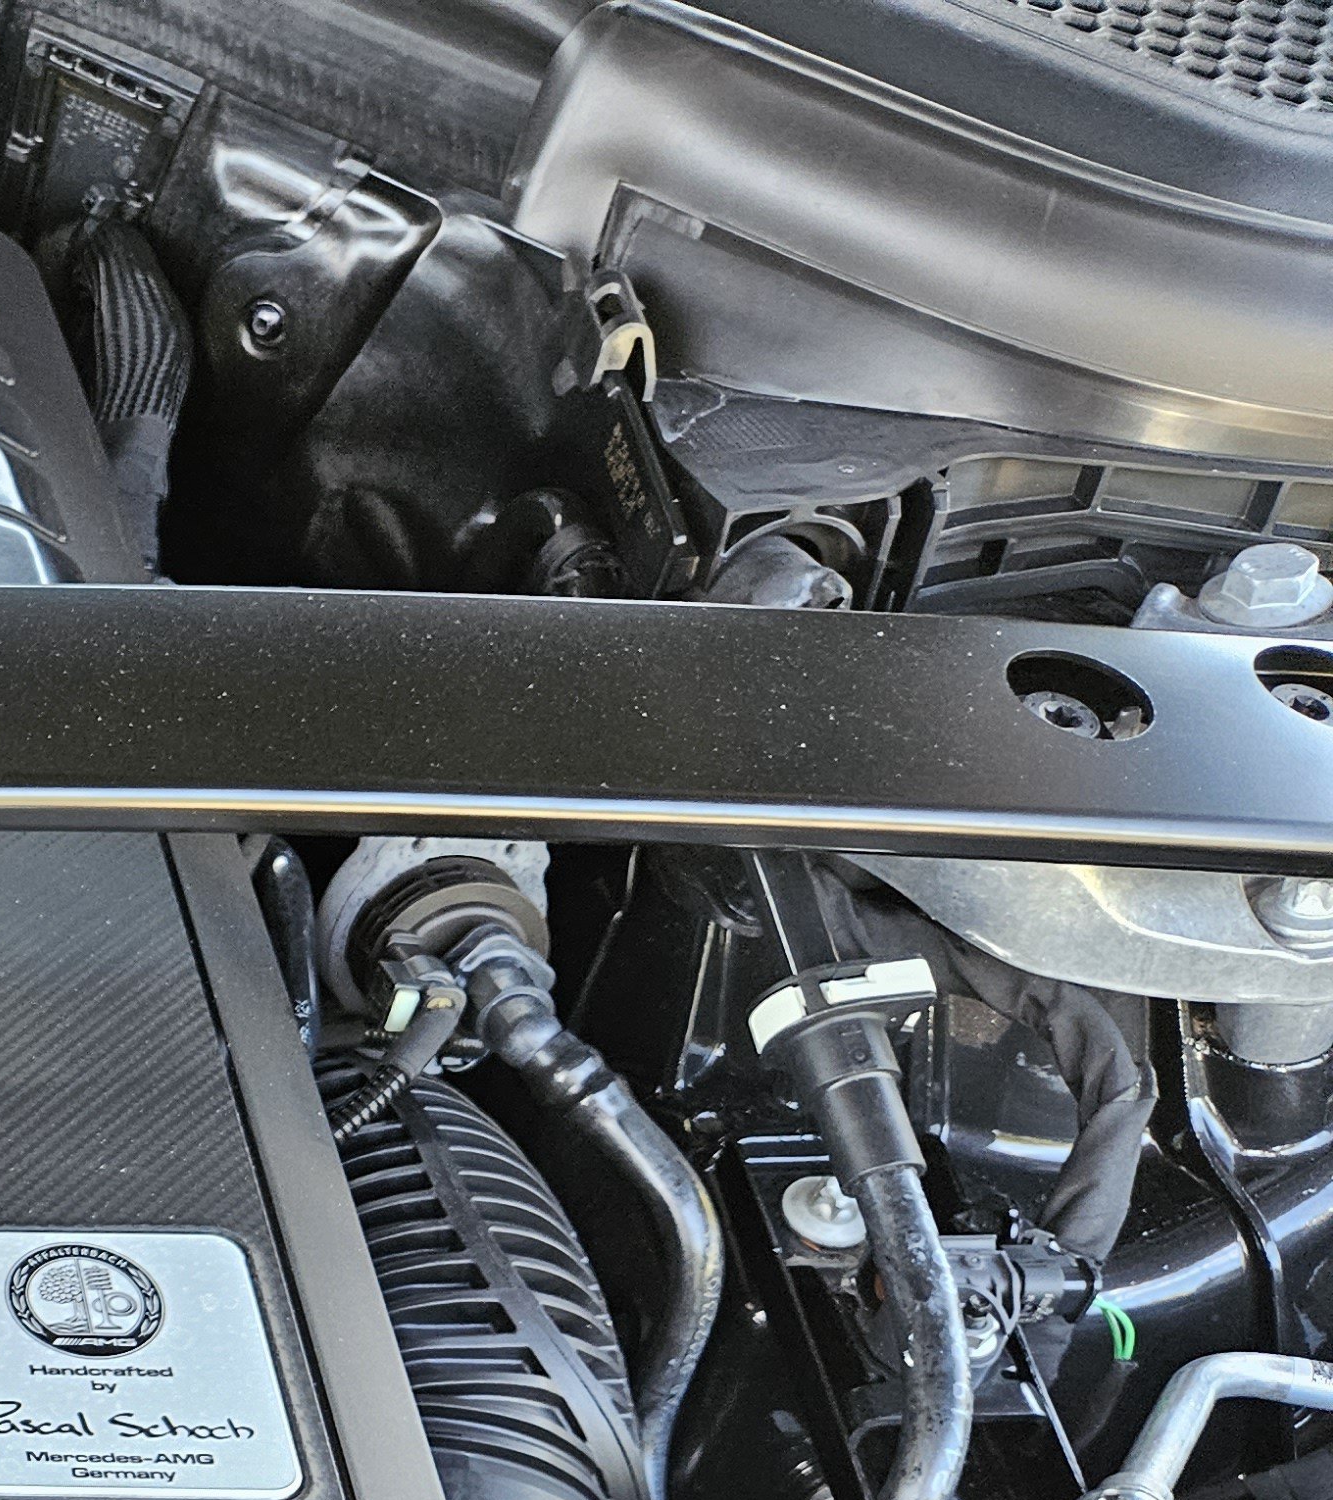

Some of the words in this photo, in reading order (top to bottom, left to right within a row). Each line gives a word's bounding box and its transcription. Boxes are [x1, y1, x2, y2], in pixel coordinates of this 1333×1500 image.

[27, 1246, 129, 1269] AFFALTERBACH
[81, 1337, 138, 1348] AMG
[28, 1364, 174, 1378] Handcrafted
[91, 1380, 117, 1394] by
[26, 1450, 215, 1466] Mercedes-AMG
[71, 1467, 176, 1482] Germany
